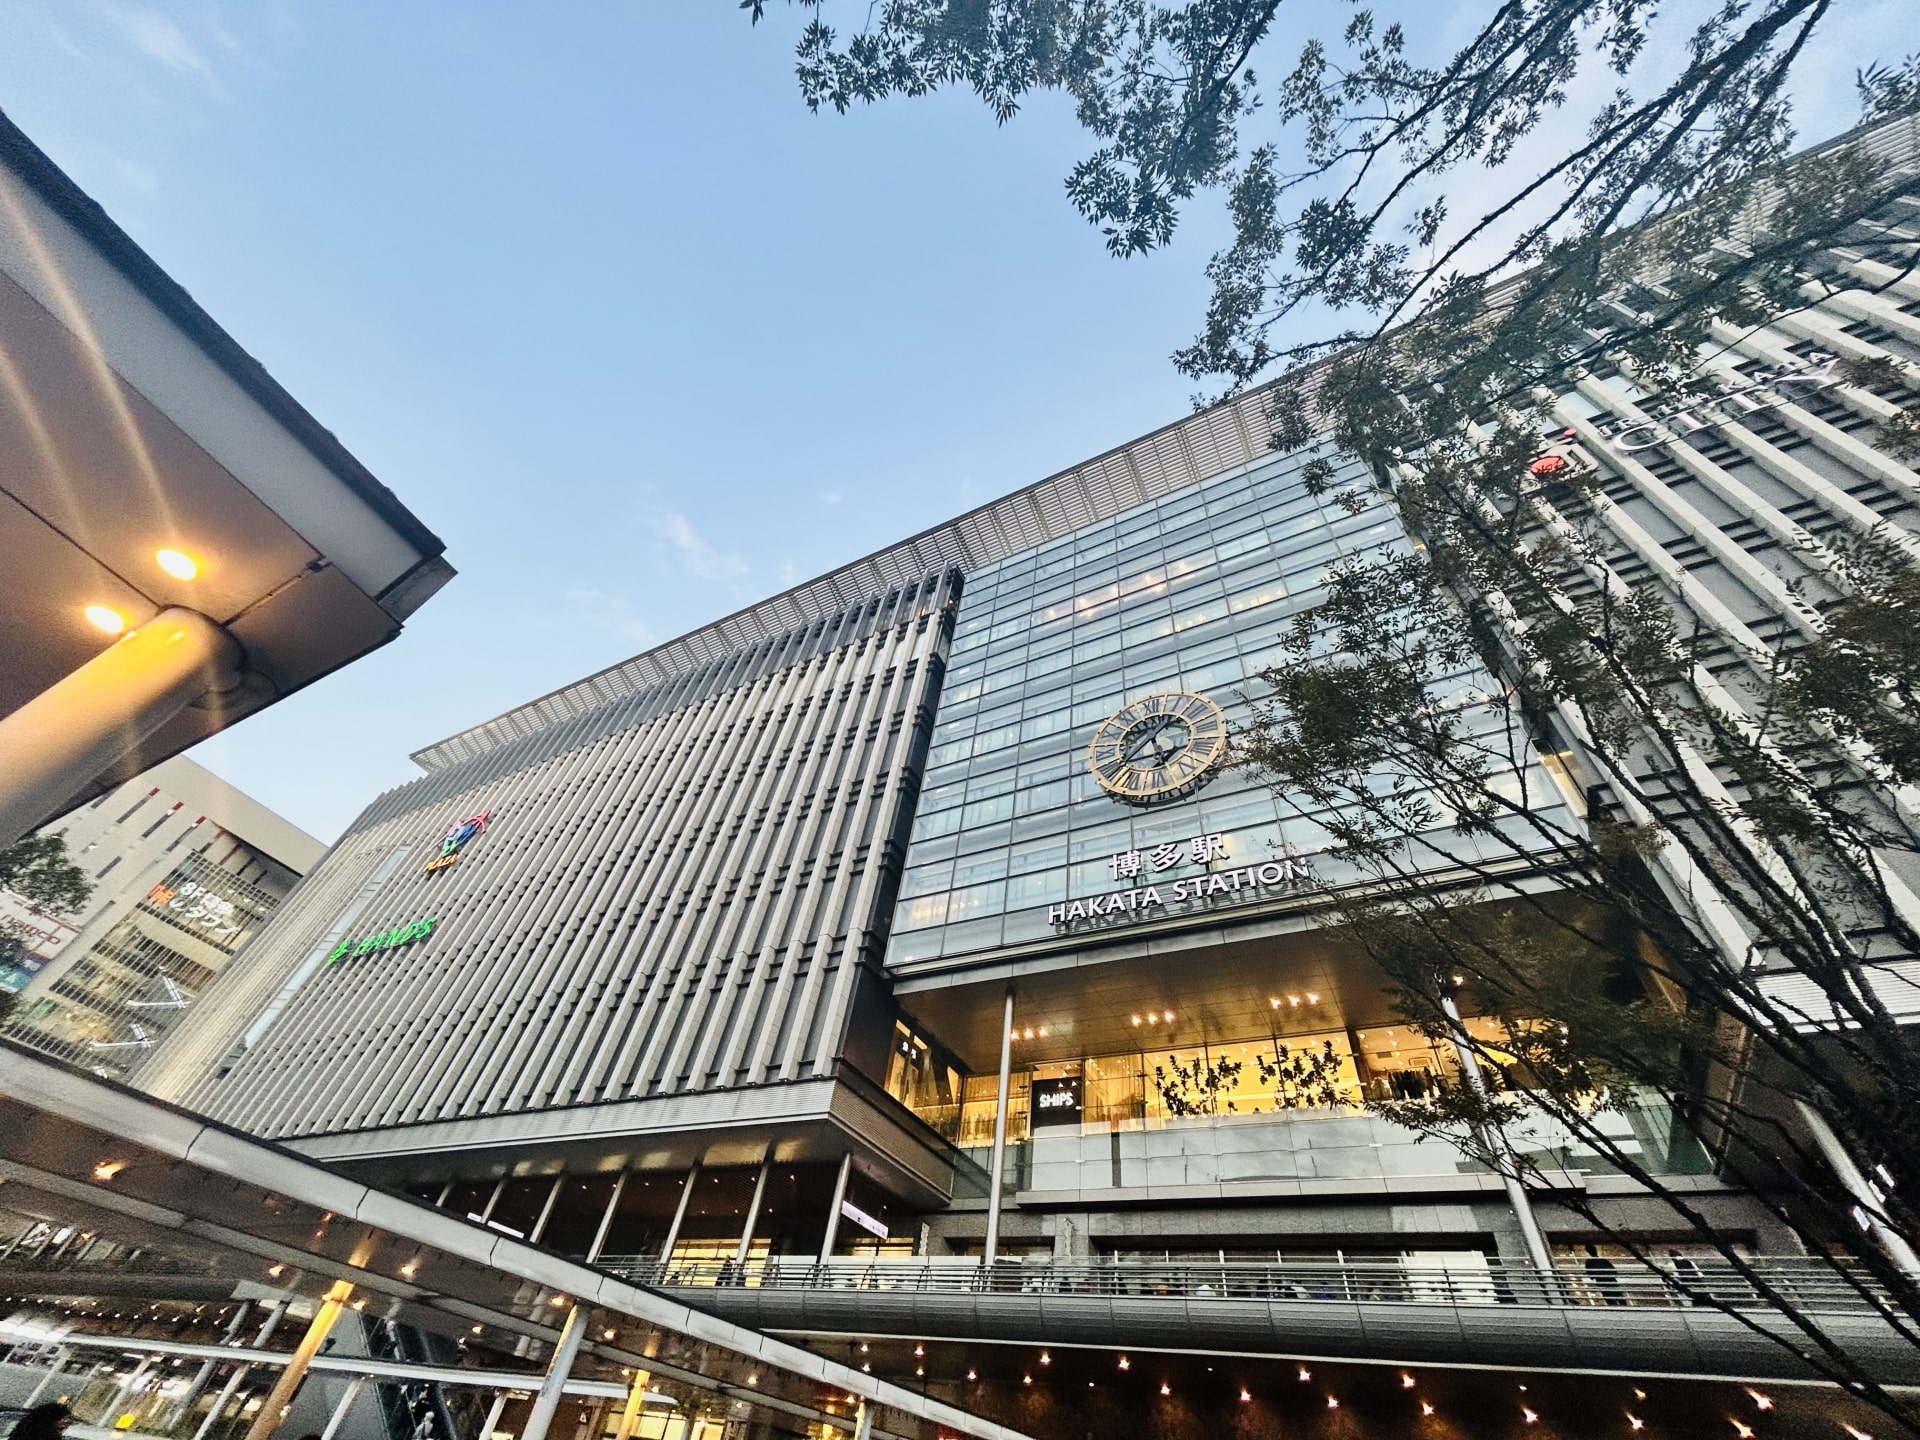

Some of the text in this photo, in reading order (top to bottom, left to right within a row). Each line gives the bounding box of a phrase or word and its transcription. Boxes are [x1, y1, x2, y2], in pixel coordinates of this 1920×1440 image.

[1598, 417, 1640, 438] JR
[1613, 357, 1843, 452] CITY
[1108, 832, 1231, 882] 博多駅
[1047, 857, 1311, 926] HAKATA STATION
[351, 916, 438, 958] HANDS
[1039, 1091, 1074, 1108] SHIPS
